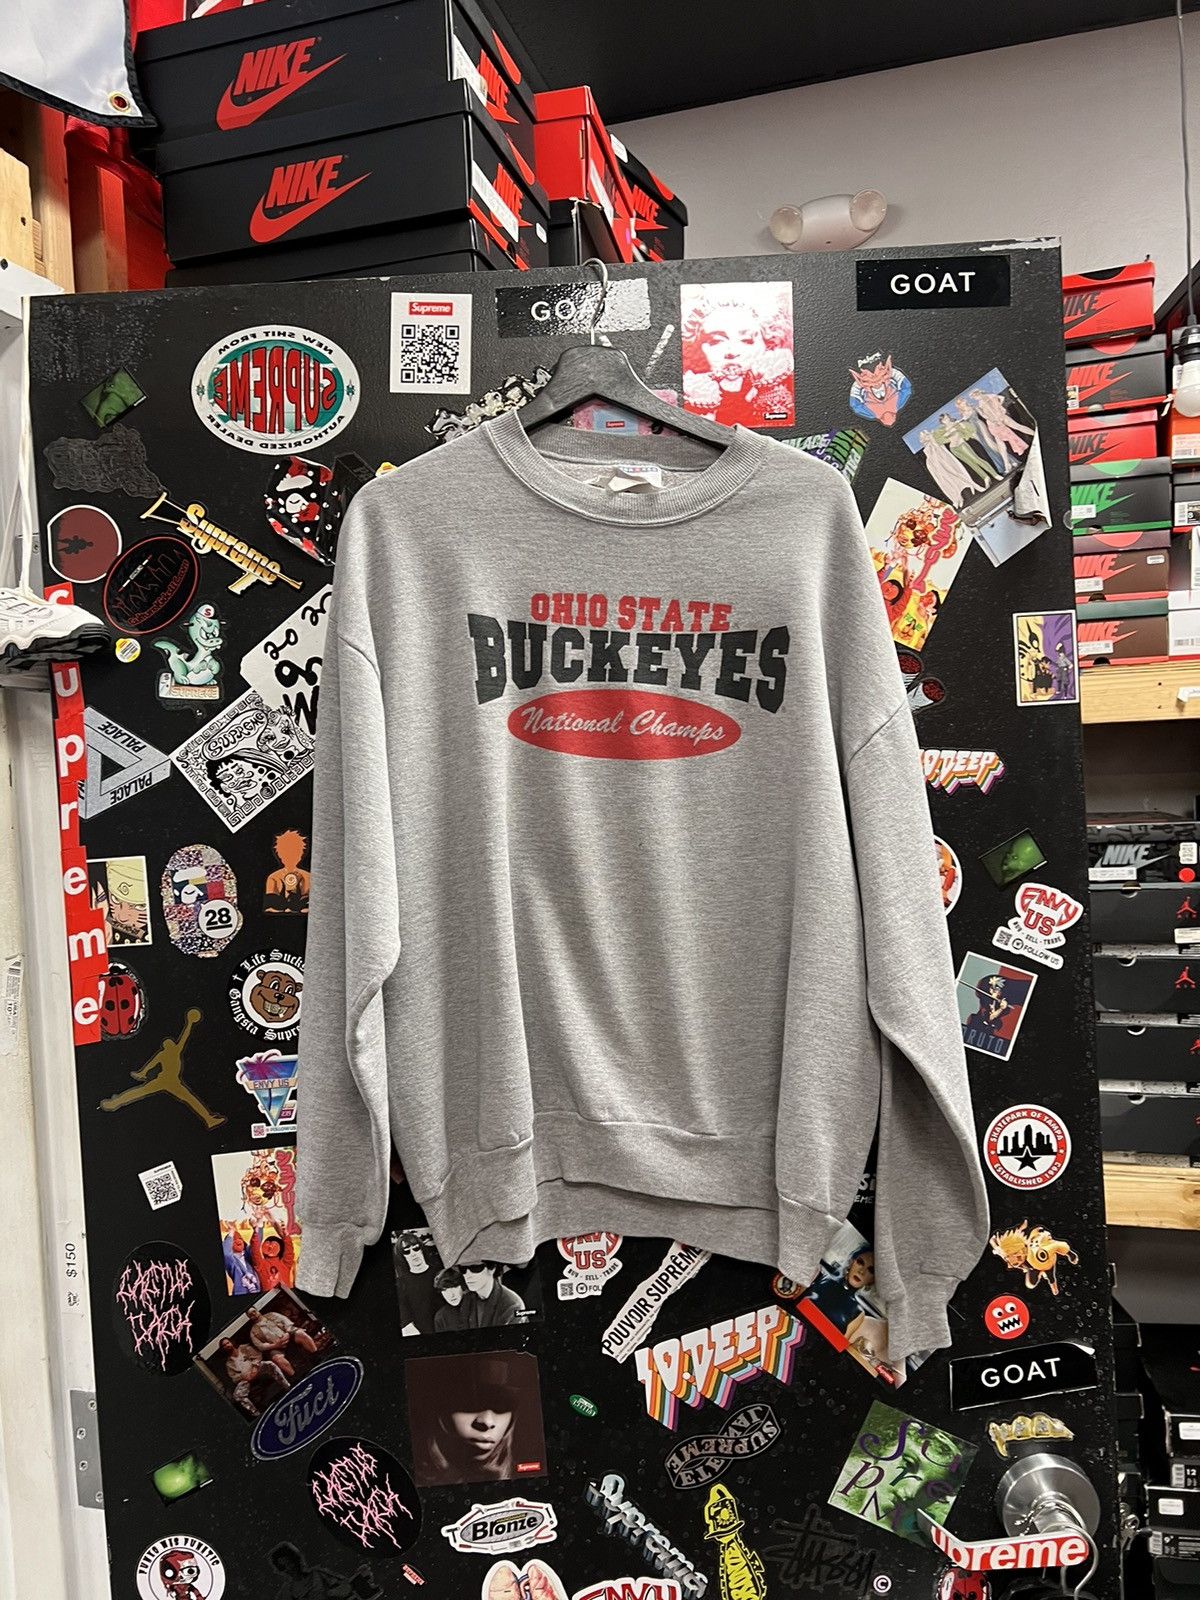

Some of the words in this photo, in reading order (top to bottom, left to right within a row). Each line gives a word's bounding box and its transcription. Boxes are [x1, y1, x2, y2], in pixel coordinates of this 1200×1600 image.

[232, 37, 318, 96] NIKE
[265, 154, 345, 208] NIKE
[890, 271, 975, 295] GOAT
[411, 302, 450, 314] Supreme
[1068, 362, 1116, 386] NIKE
[1071, 483, 1117, 506] NIKE
[180, 503, 281, 583] Supreme
[1074, 554, 1118, 578] NIKE
[531, 593, 607, 628] OHIO
[617, 597, 732, 632] STATE
[467, 613, 790, 714] BUCKEYES
[98, 720, 147, 752] PALACE
[520, 706, 621, 734] National
[629, 710, 726, 741] Champs
[110, 772, 153, 805] PALACE
[1102, 844, 1151, 866] NIKE
[205, 907, 232, 927] 28
[1021, 887, 1078, 927] ENVY
[1024, 909, 1055, 936] US
[240, 953, 266, 972] Life
[1023, 944, 1049, 960] FOLLOW
[1050, 957, 1060, 965] US
[229, 988, 258, 1035] Gangsta
[964, 1026, 1004, 1055] RUTO
[254, 1080, 274, 1089] ENVY
[278, 1078, 288, 1087] US
[990, 1109, 1028, 1142] SKATEPARK
[1030, 1110, 1042, 1119] OF
[1043, 1116, 1063, 1141] TAMPA
[994, 1163, 1043, 1185] ESTABLISHED
[65, 1243, 77, 1278] $150
[574, 1250, 606, 1269] US
[601, 1297, 654, 1355] POUVOIR
[980, 1357, 1061, 1388] GOAT
[667, 1420, 778, 1474] SUPREME
[472, 1515, 537, 1542] Bronze
